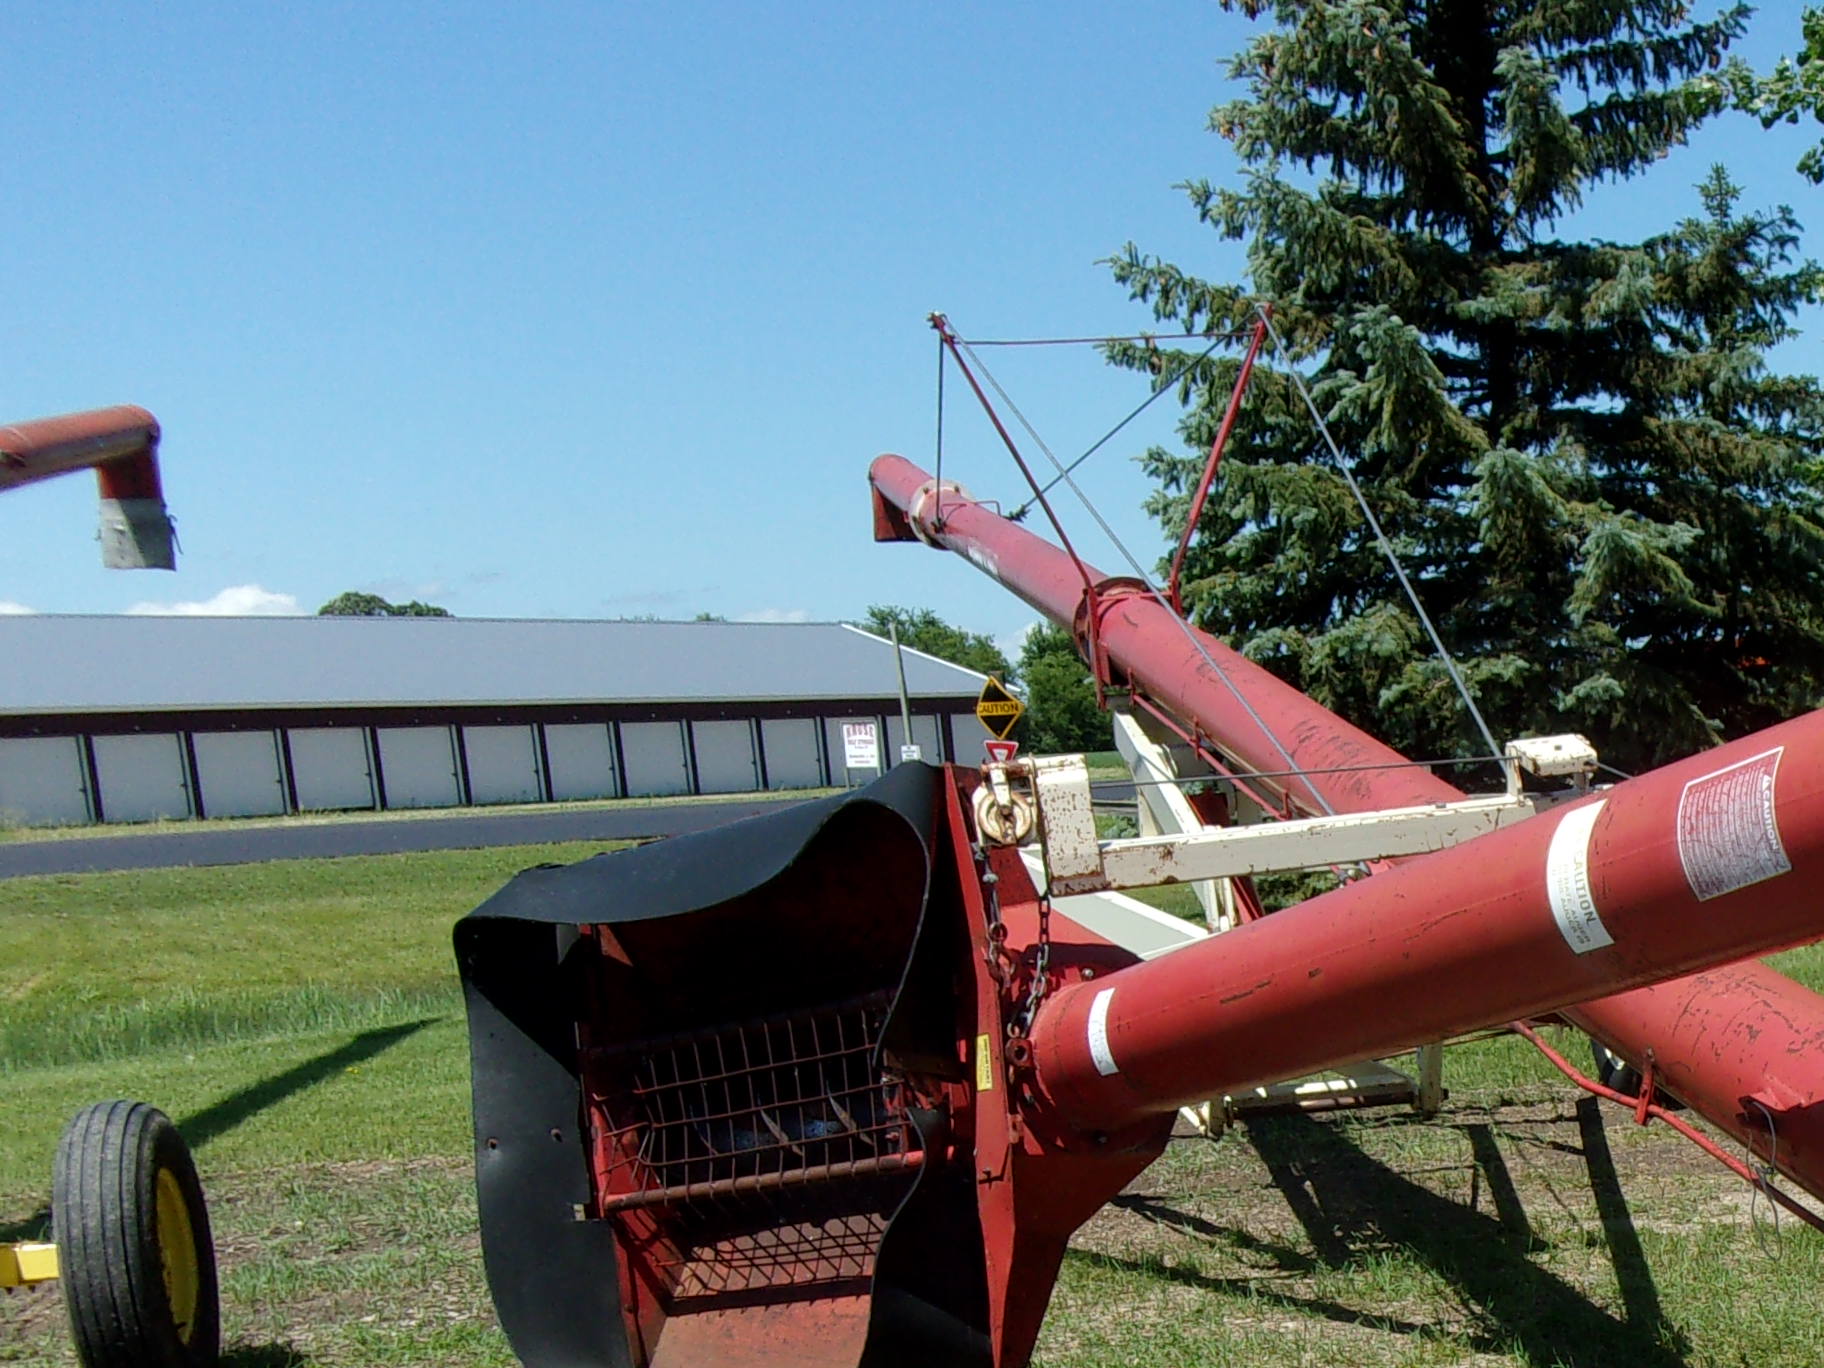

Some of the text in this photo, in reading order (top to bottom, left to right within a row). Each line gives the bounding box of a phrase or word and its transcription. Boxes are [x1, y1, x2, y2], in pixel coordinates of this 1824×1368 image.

[979, 703, 1019, 713] CAUTION
[1763, 791, 1780, 850] CAUTION
[1573, 850, 1597, 927] CAUTION
